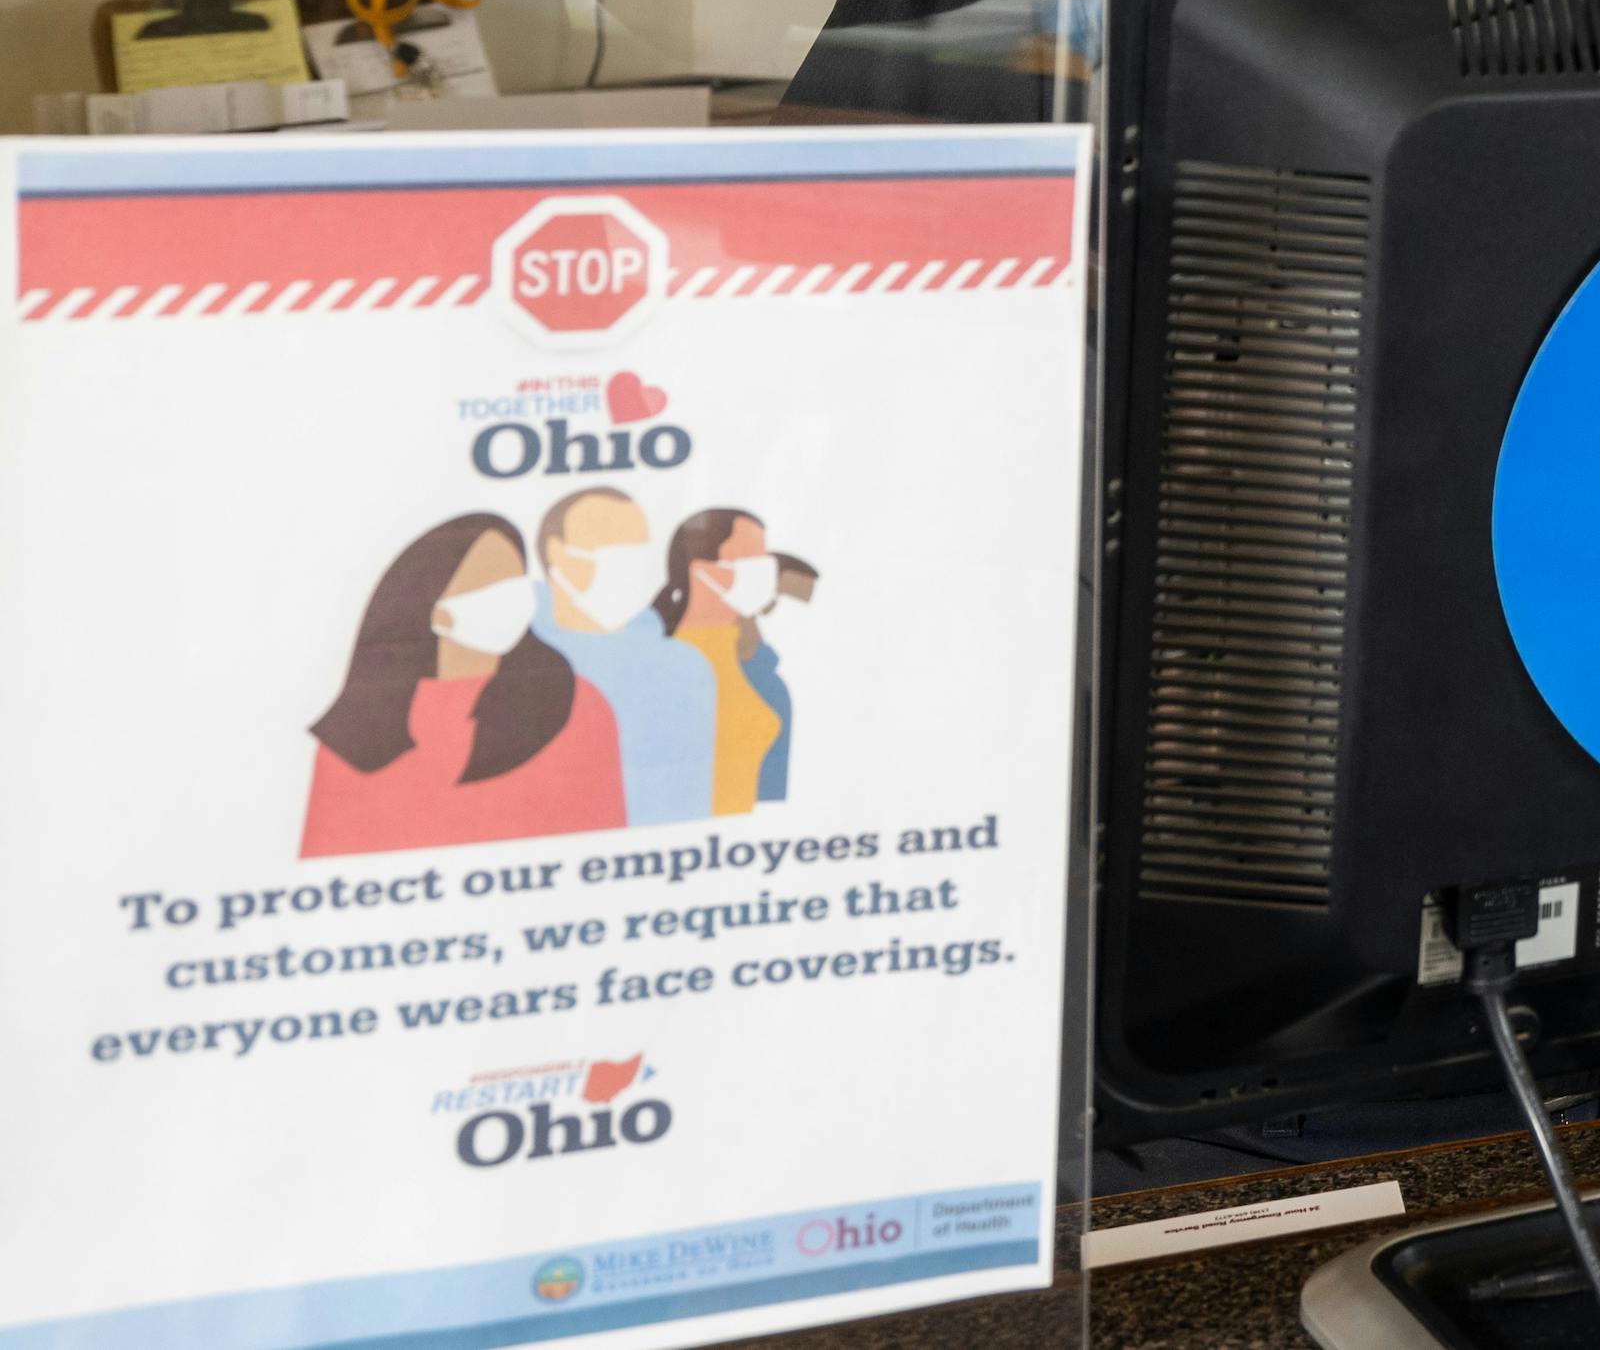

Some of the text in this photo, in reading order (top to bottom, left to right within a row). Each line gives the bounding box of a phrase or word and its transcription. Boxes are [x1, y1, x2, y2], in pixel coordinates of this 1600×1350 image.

[518, 247, 644, 300] STOP
[457, 392, 603, 422] TOGETHER
[470, 417, 694, 480] Ohio
[119, 812, 1003, 937] To protect our employees and
[163, 875, 961, 994] customers, we require that
[88, 932, 1019, 1067] everyone wears face coverings.
[430, 1071, 584, 1114] RESTART
[455, 1096, 675, 1169] Ohio
[794, 1212, 903, 1257] Ohio
